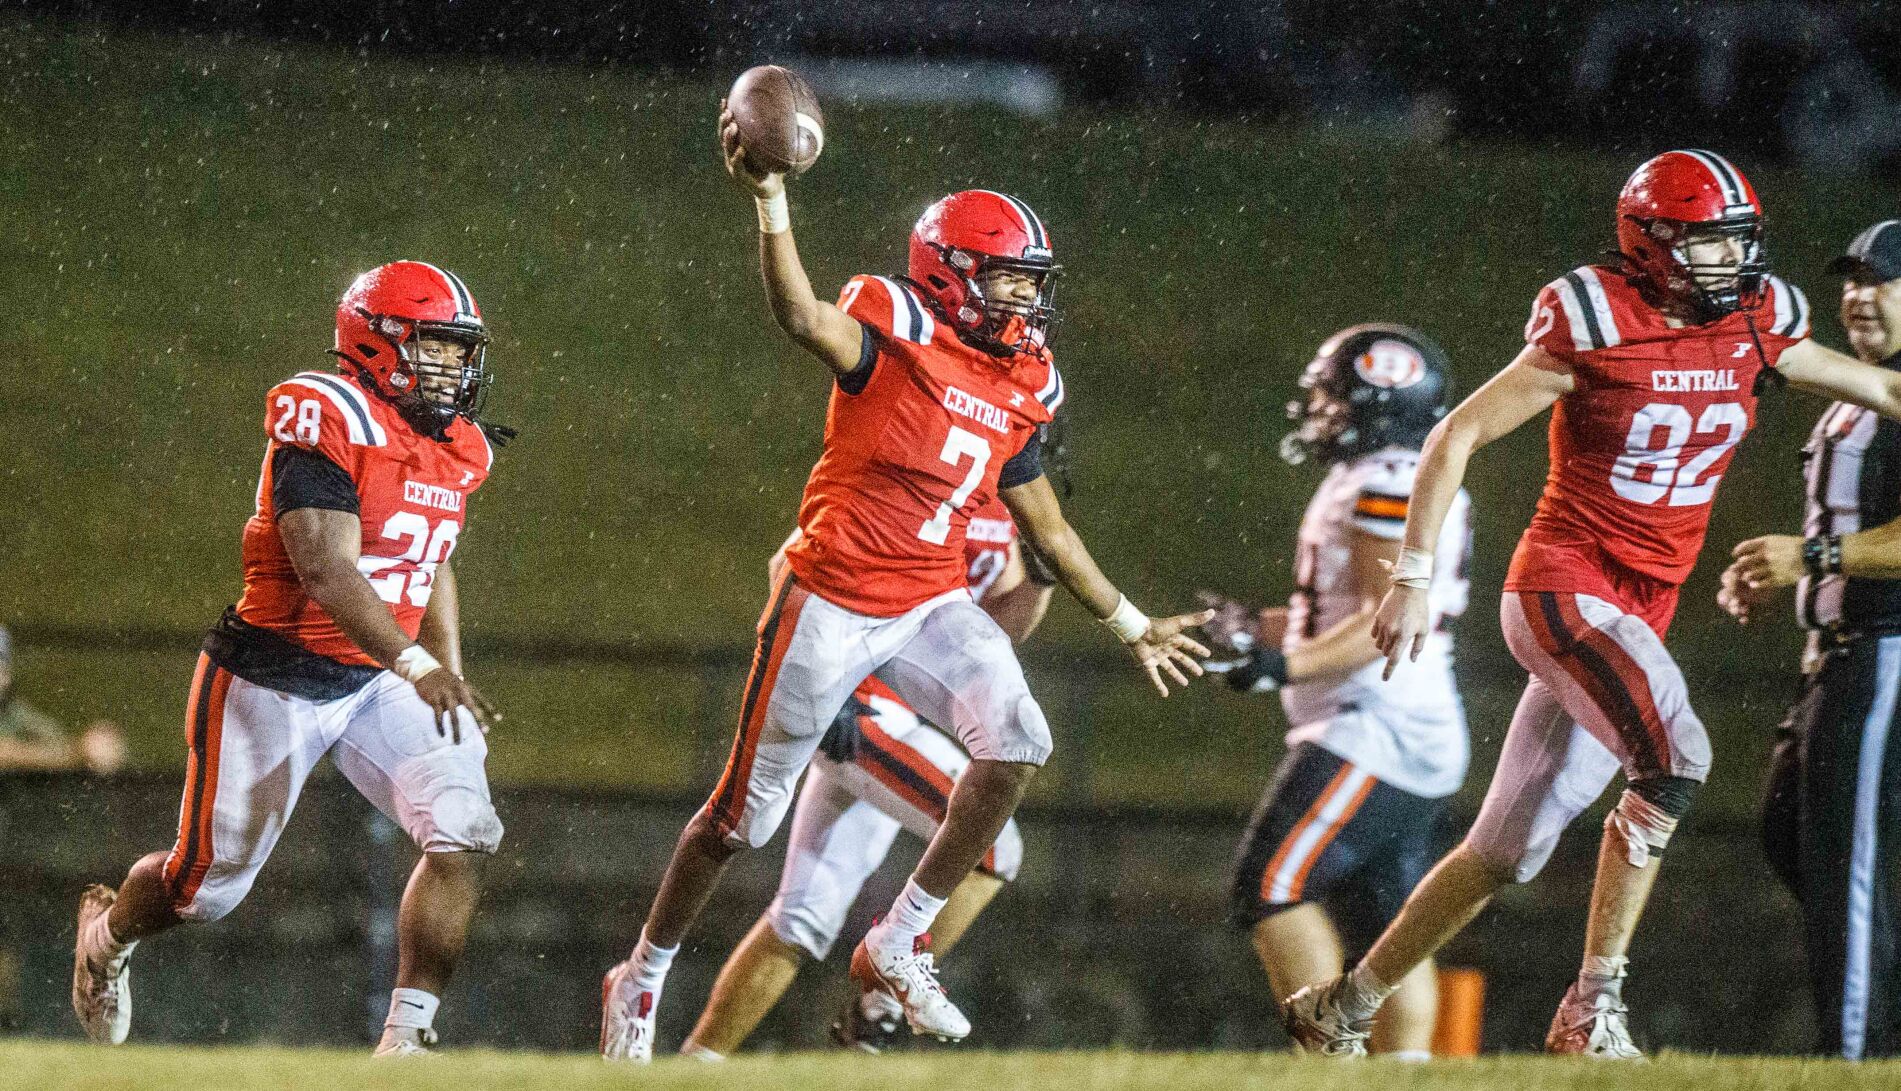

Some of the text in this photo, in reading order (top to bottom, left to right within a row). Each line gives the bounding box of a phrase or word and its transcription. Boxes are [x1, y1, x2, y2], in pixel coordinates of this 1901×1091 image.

[841, 280, 864, 313] 7
[1652, 370, 1739, 391] CENTRAL
[275, 395, 321, 446] 28
[944, 386, 1010, 434] CENTRAL
[1608, 402, 1748, 506] 82
[404, 480, 461, 512] CENTRAL
[917, 425, 992, 546] 7
